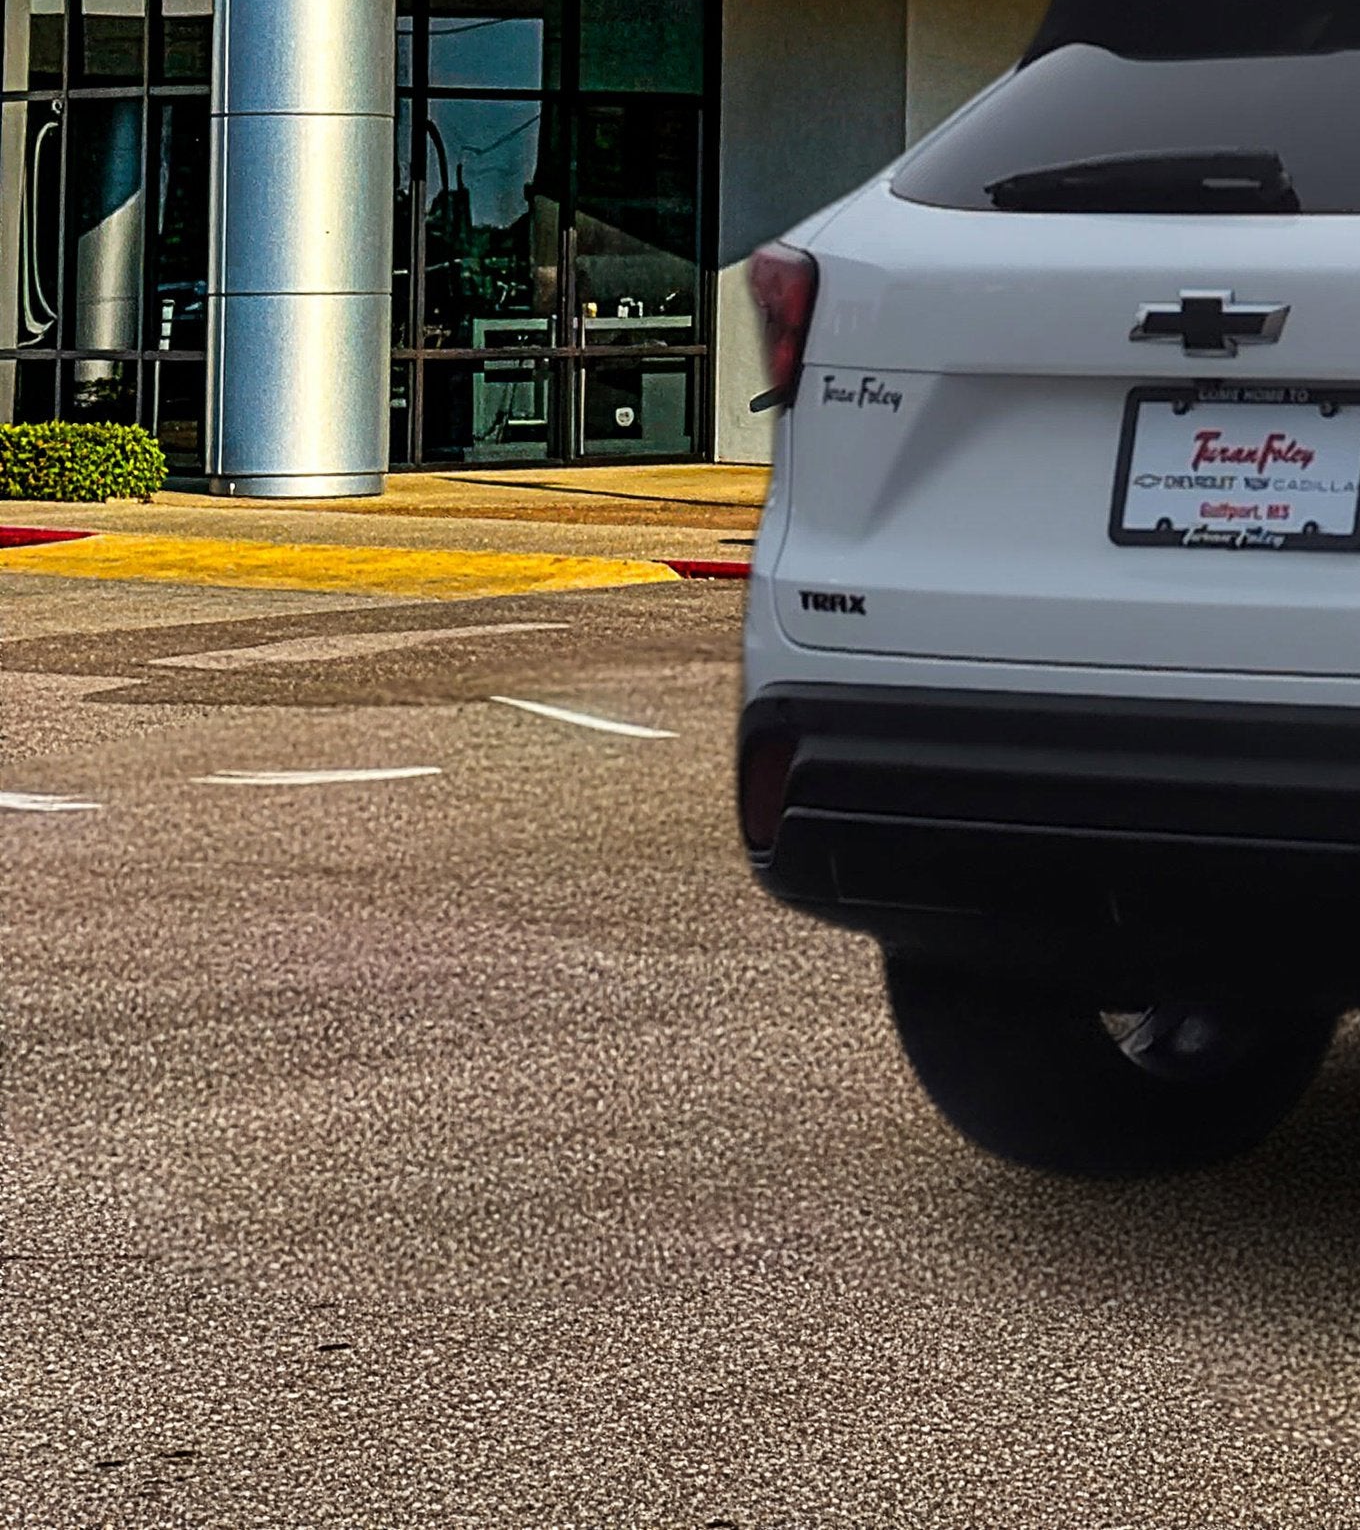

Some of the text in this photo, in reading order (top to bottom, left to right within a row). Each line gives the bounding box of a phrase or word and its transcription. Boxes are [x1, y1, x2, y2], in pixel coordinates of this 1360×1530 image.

[858, 376, 903, 413] Foley
[1191, 430, 1315, 475] Turan Foley
[1273, 478, 1360, 493] CADILLA
[799, 590, 867, 616] TRAX
